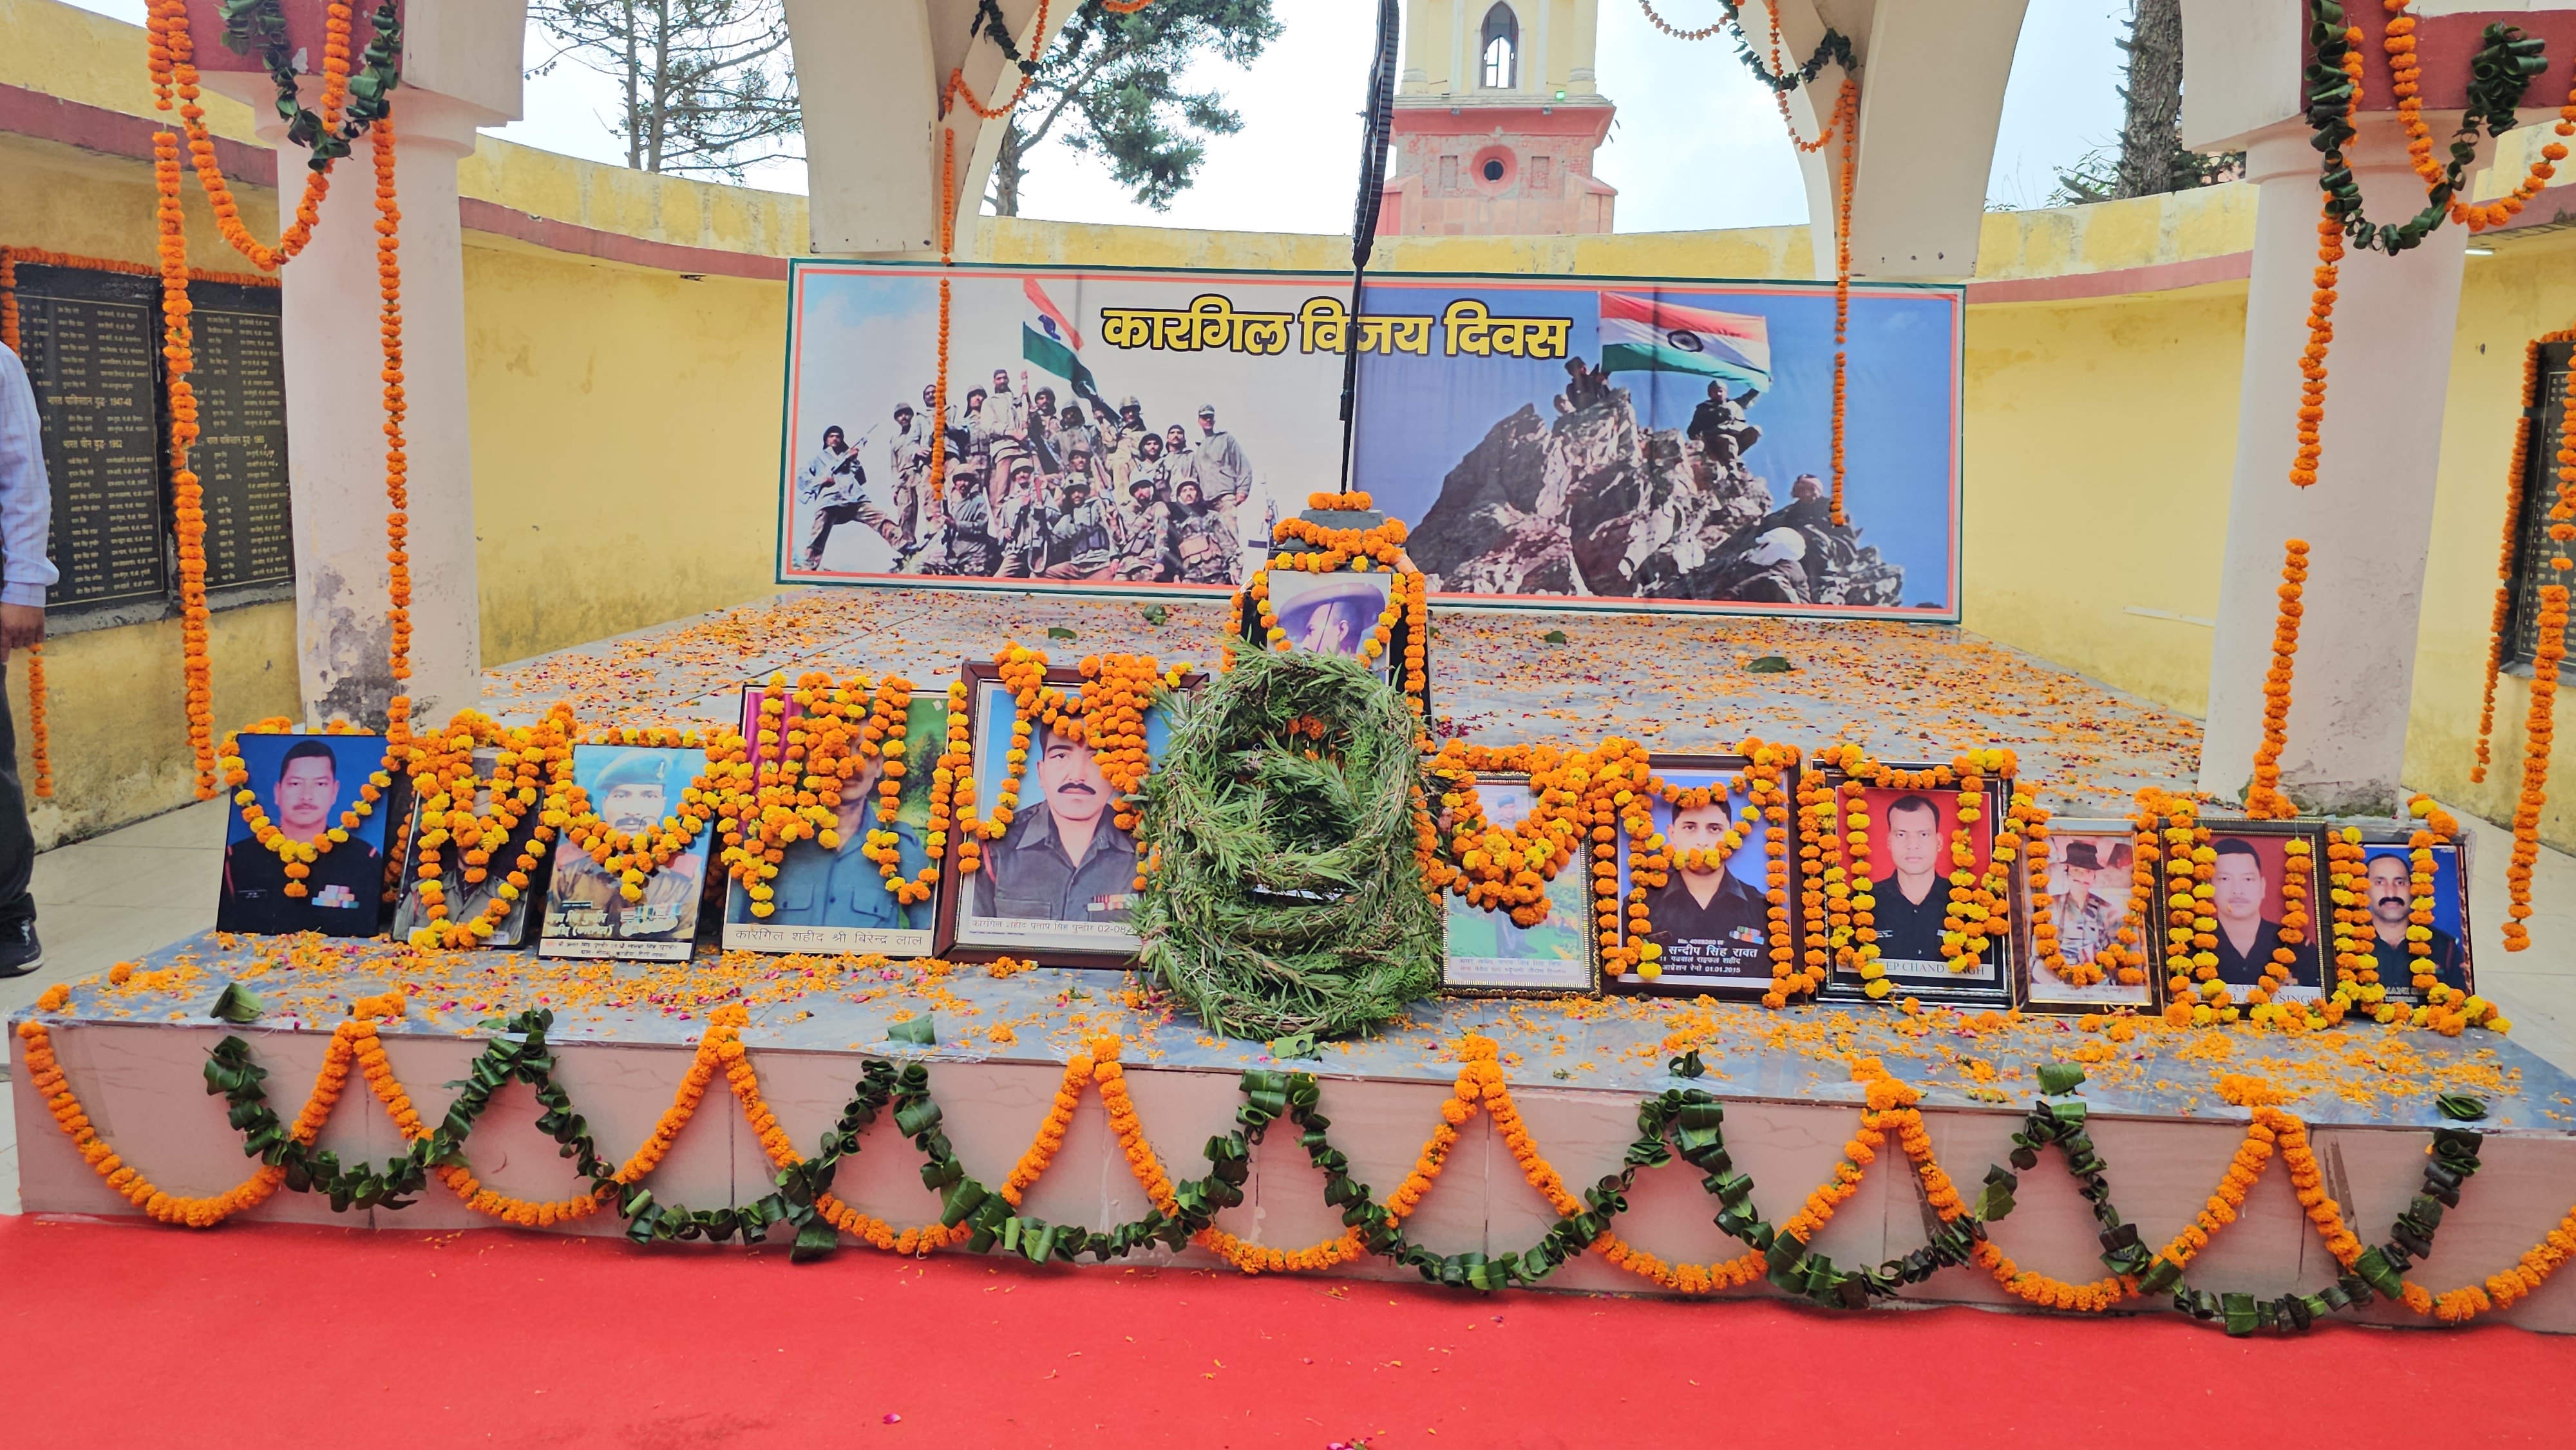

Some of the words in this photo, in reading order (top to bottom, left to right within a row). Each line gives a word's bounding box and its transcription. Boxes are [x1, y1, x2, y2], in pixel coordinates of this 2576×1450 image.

[1102, 294, 1294, 355] कारगिल
[1300, 296, 1434, 357] विजय
[1443, 299, 1572, 360] दिवस
[735, 927, 784, 941] कारगिल
[791, 931, 824, 943] शहीद
[832, 930, 846, 943] श्री
[896, 934, 922, 946] लाल
[1668, 944, 1701, 956] सन्दीप
[1706, 945, 1728, 956] सिंह
[1732, 948, 1758, 957] रावत
[1902, 963, 1944, 974] CHAND
